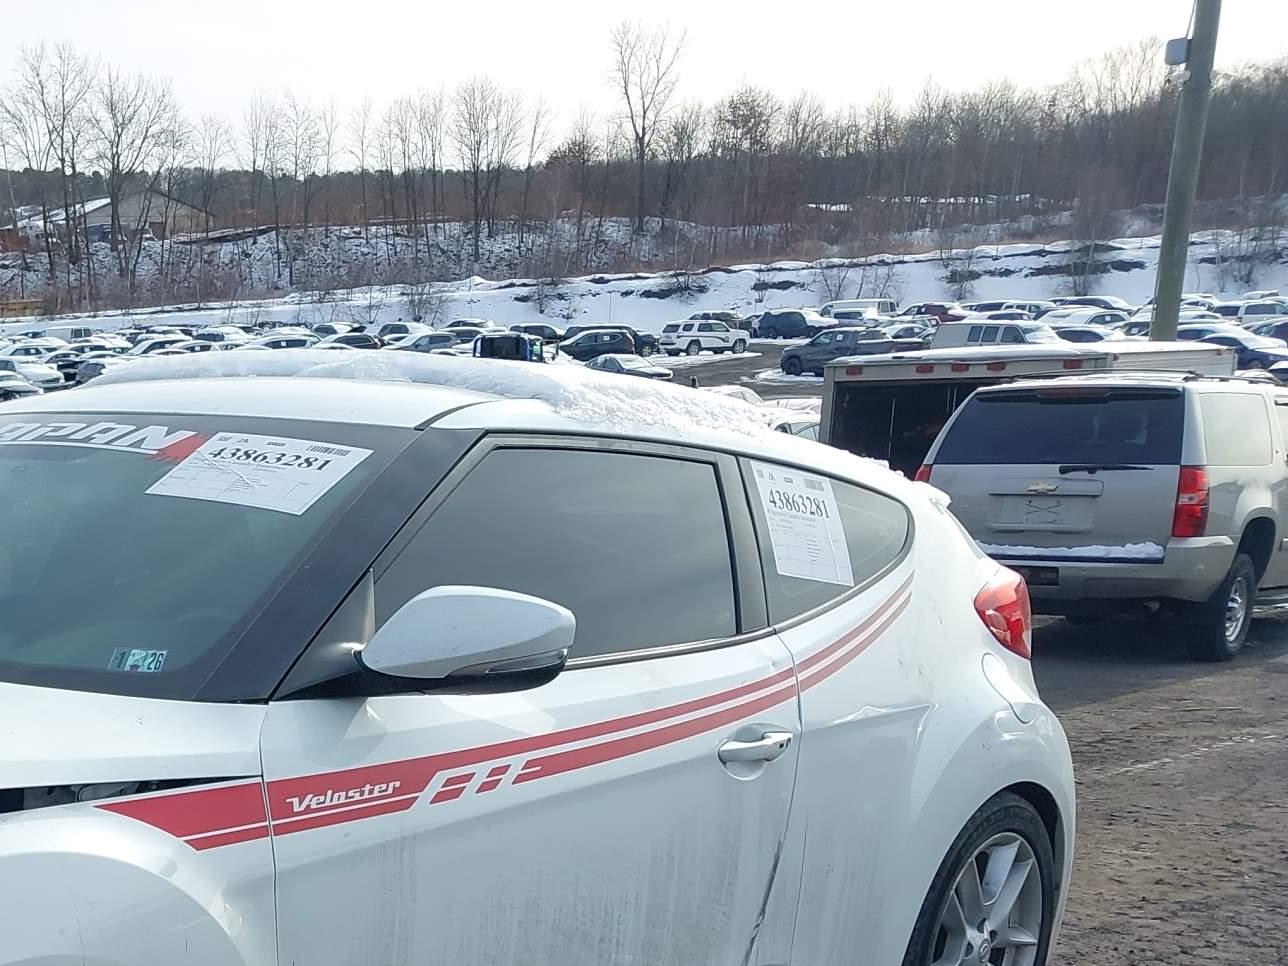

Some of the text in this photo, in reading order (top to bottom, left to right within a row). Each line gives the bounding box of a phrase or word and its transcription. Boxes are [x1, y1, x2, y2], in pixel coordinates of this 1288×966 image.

[209, 445, 332, 472] 43863281
[769, 488, 830, 518] 43863281
[146, 652, 164, 671] 26
[285, 780, 401, 813] Veloster
